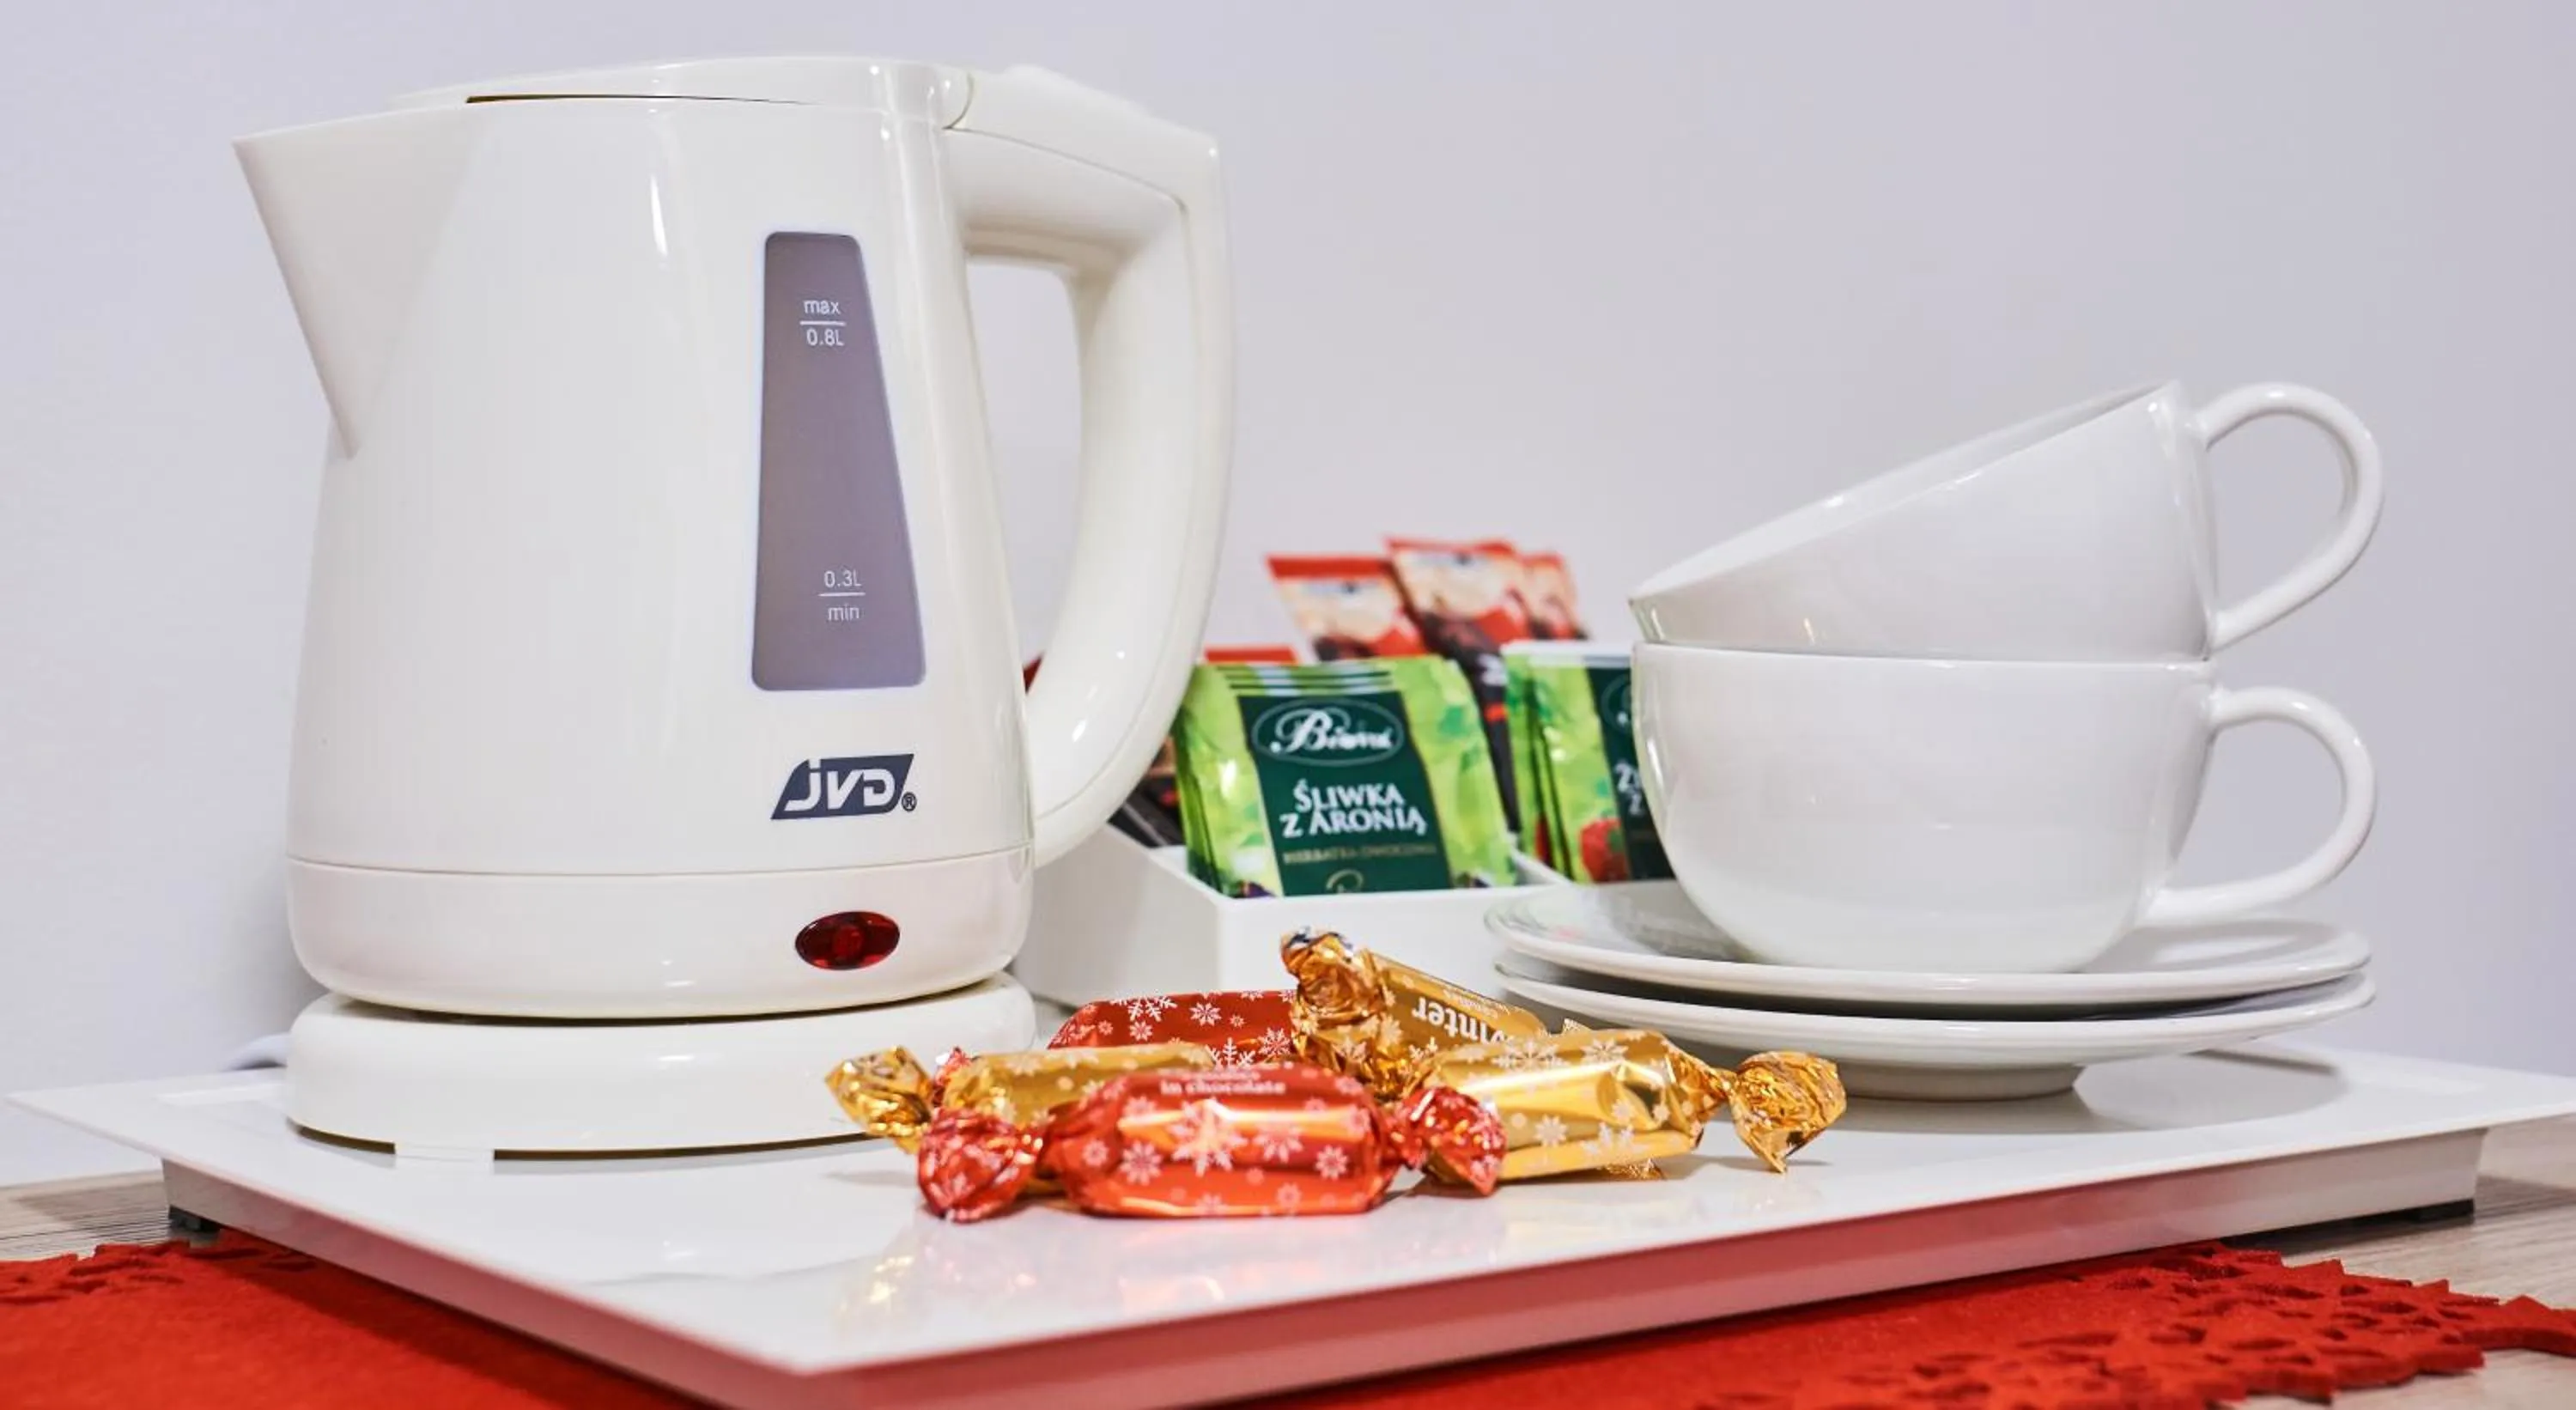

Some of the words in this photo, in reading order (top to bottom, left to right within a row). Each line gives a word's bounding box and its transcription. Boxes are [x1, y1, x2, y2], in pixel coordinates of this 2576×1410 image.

[804, 300, 841, 315] max
[806, 327, 845, 346] 0.8L
[824, 569, 862, 588] 0.3L
[827, 604, 860, 621] min
[1293, 778, 1406, 812] ŚLIWKA
[1309, 806, 1428, 836] ARONIĄ
